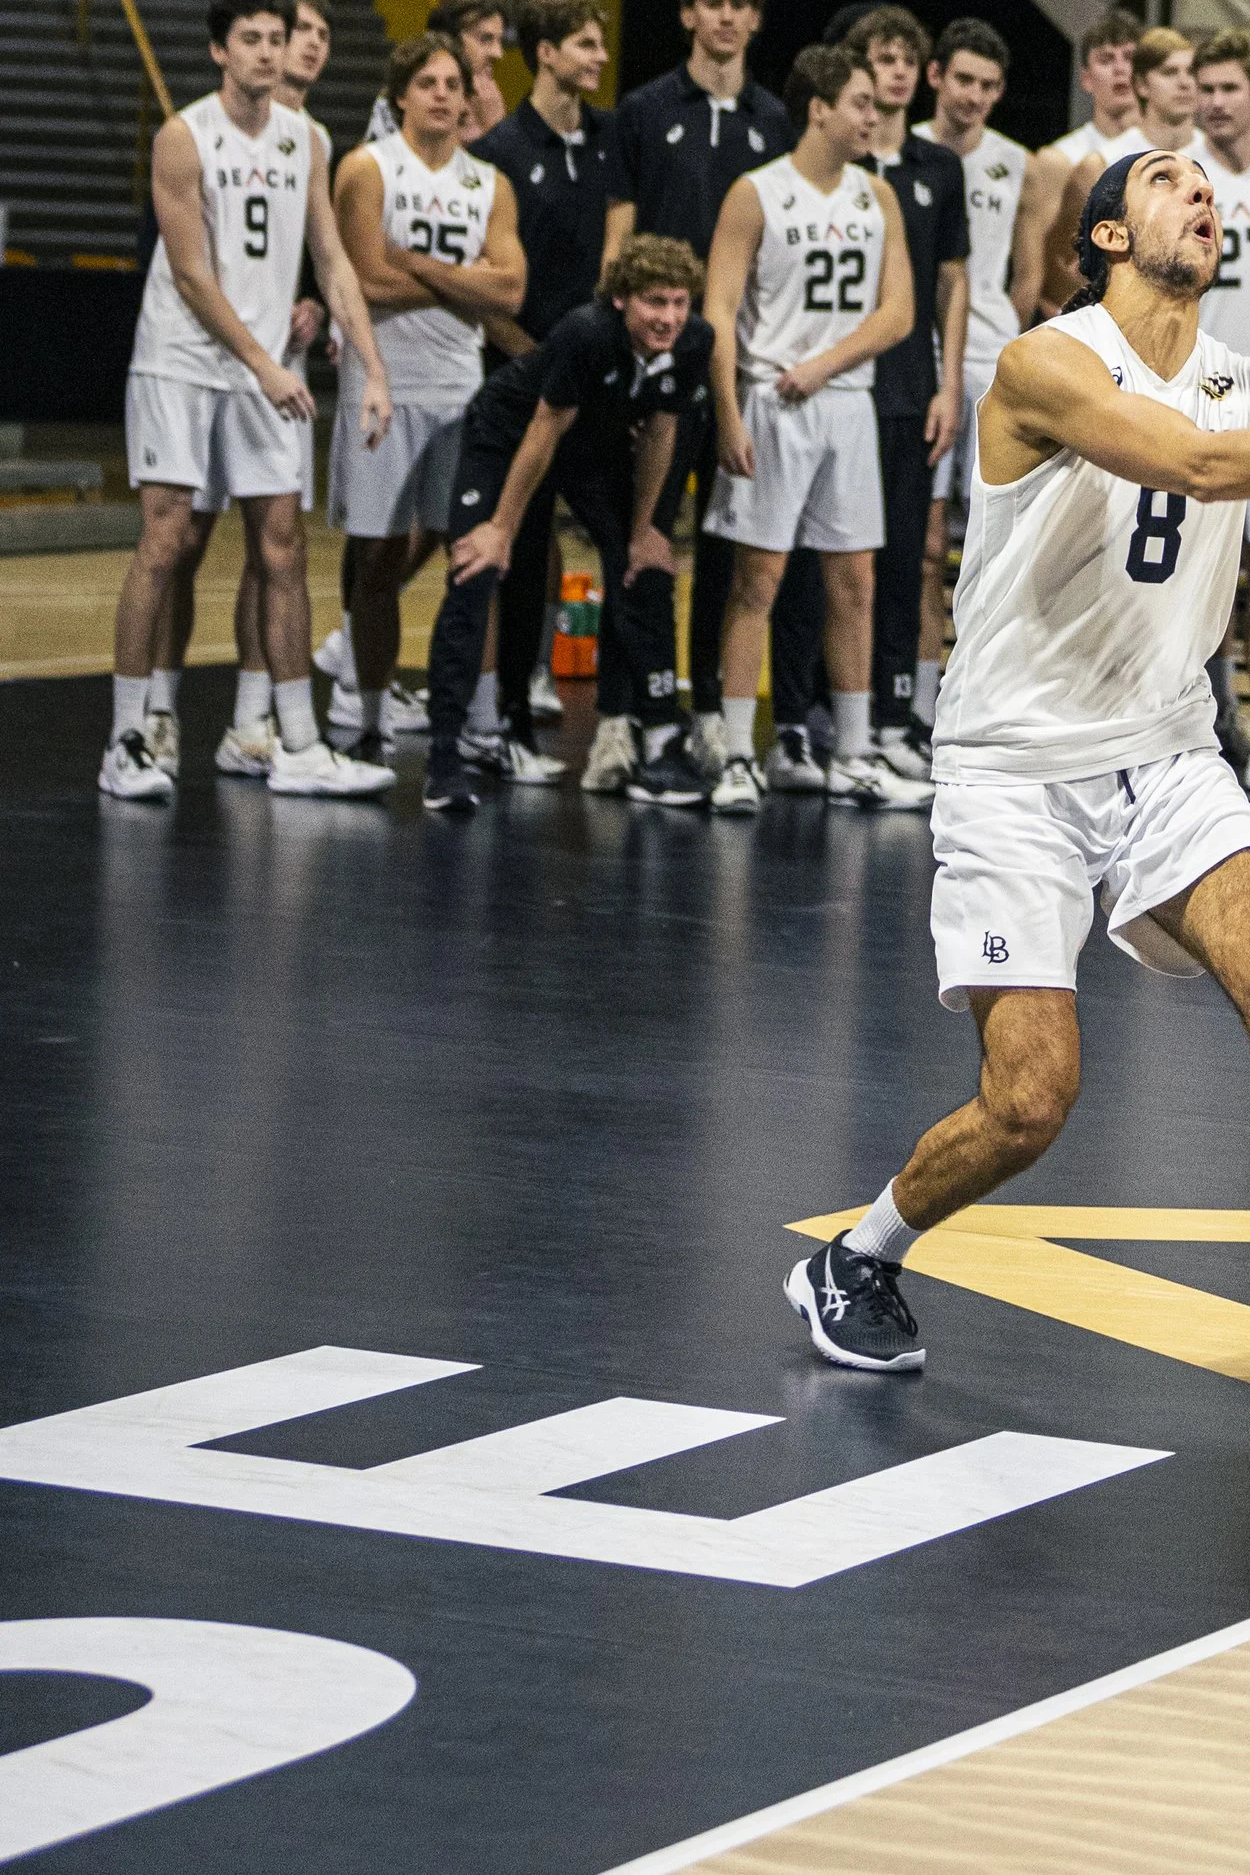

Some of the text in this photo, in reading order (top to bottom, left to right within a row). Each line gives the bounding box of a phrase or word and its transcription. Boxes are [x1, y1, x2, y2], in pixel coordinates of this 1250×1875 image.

[217, 169, 297, 189] BEACH
[244, 196, 269, 259] 9
[395, 193, 481, 223] BEACH
[411, 219, 468, 266] 25
[803, 250, 866, 312] 22
[1125, 485, 1187, 584] 8
